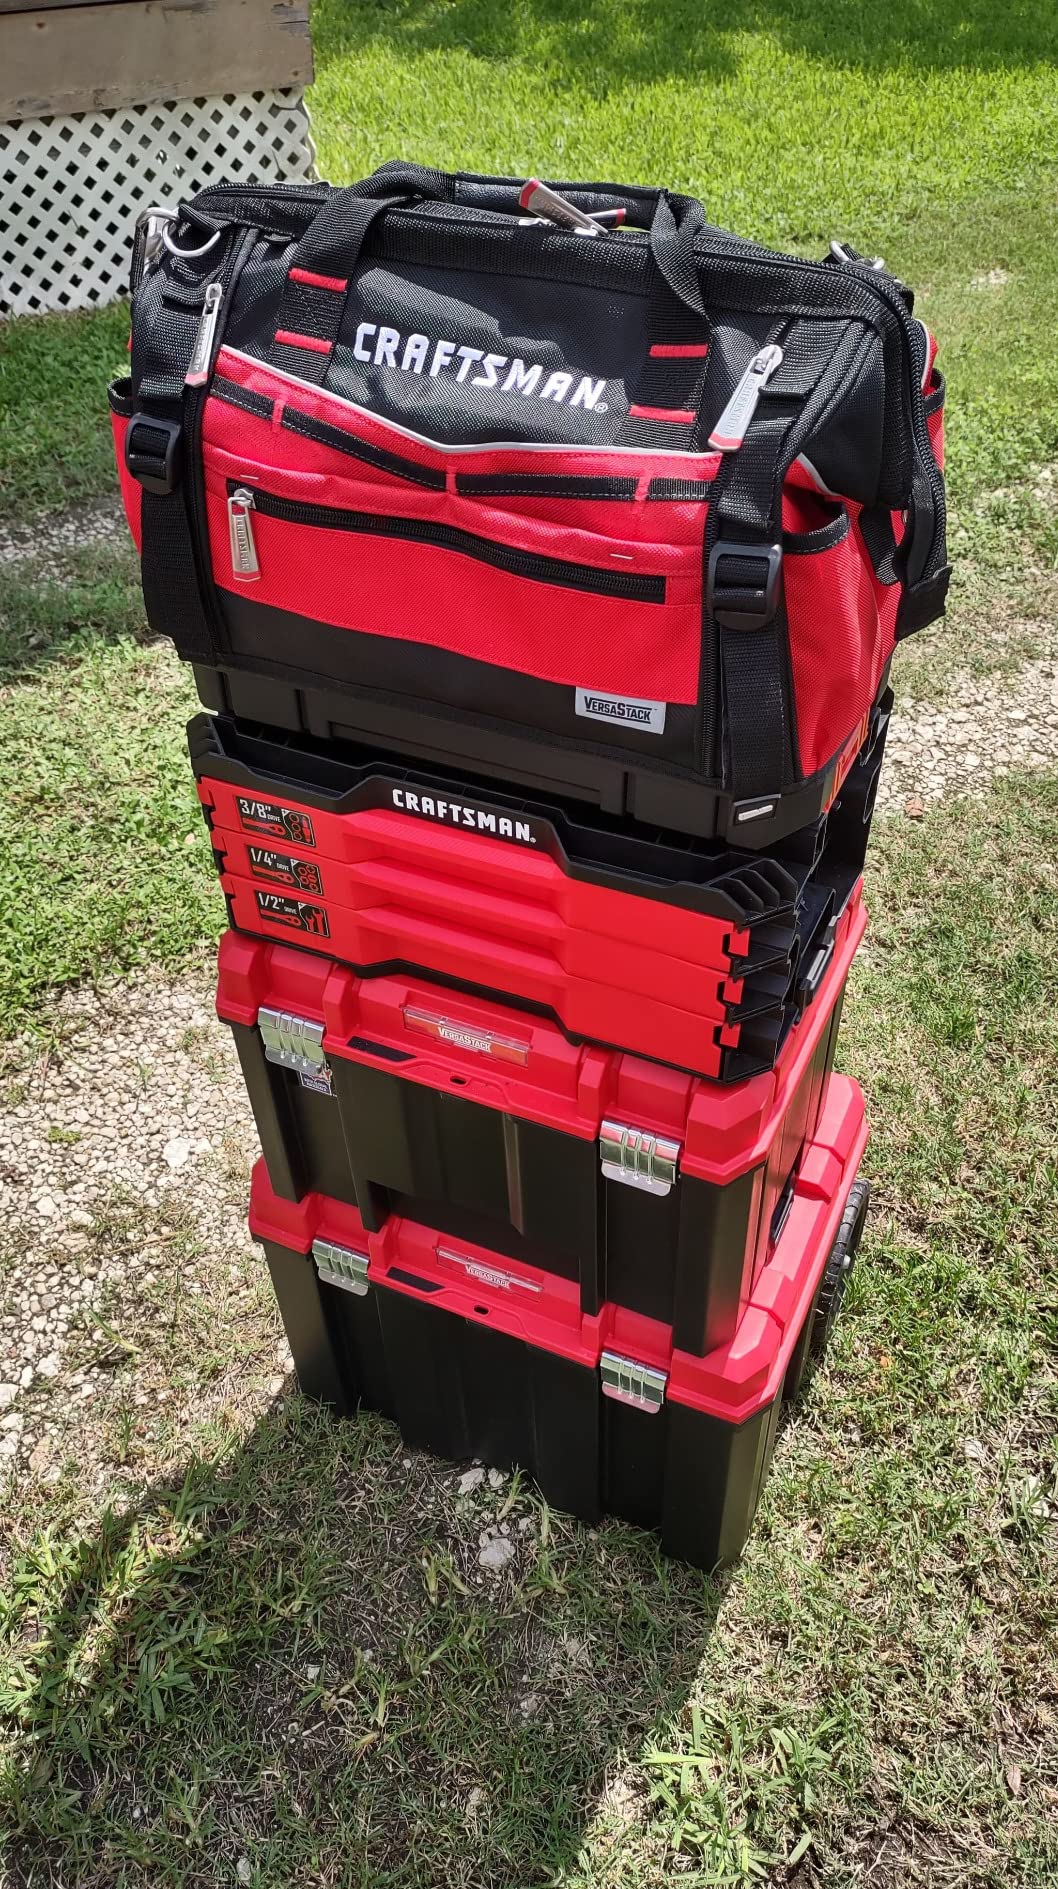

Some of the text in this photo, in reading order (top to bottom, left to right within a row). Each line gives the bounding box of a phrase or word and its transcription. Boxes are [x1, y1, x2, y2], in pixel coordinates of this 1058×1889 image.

[239, 799, 271, 819] 3/8"
[250, 847, 277, 866] 1/4"
[258, 892, 285, 910] 1/2"
